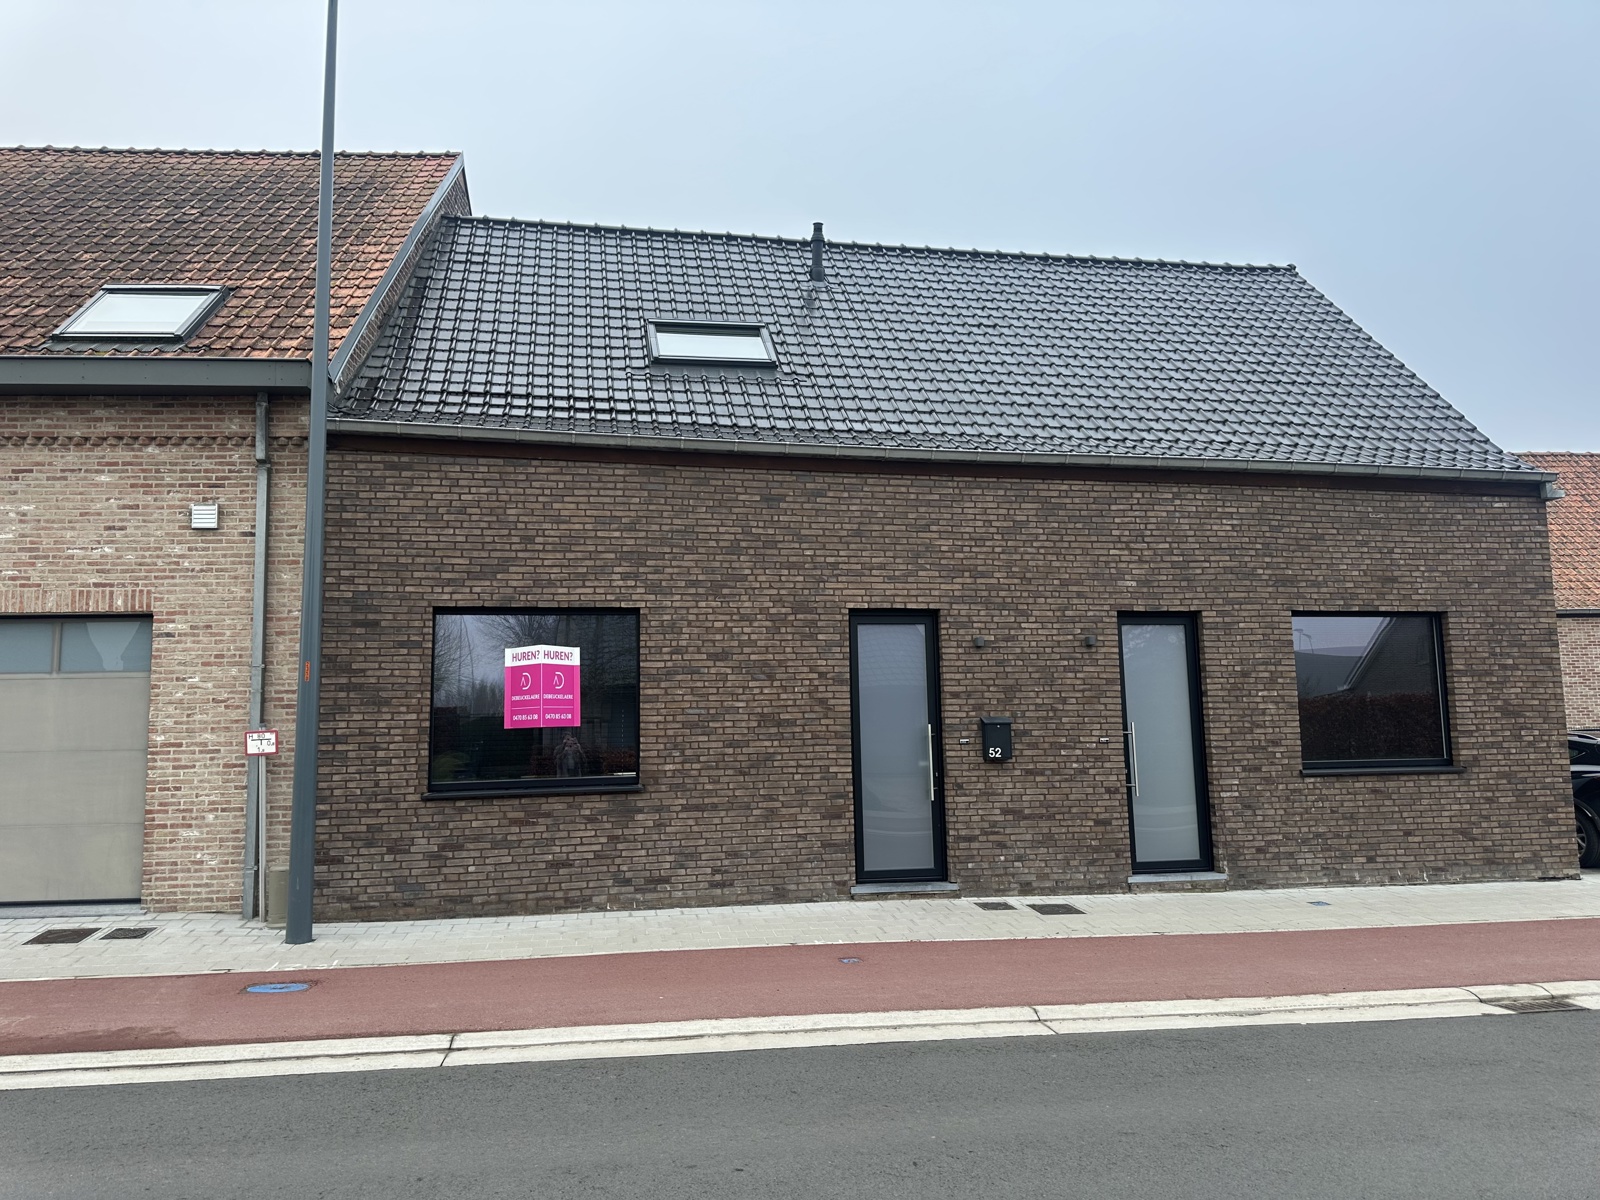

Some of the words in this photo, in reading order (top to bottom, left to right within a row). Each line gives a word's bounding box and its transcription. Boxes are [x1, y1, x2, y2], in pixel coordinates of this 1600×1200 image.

[512, 650, 540, 662] HUREN?
[543, 650, 573, 661] HUREN?
[988, 748, 1002, 758] 52
